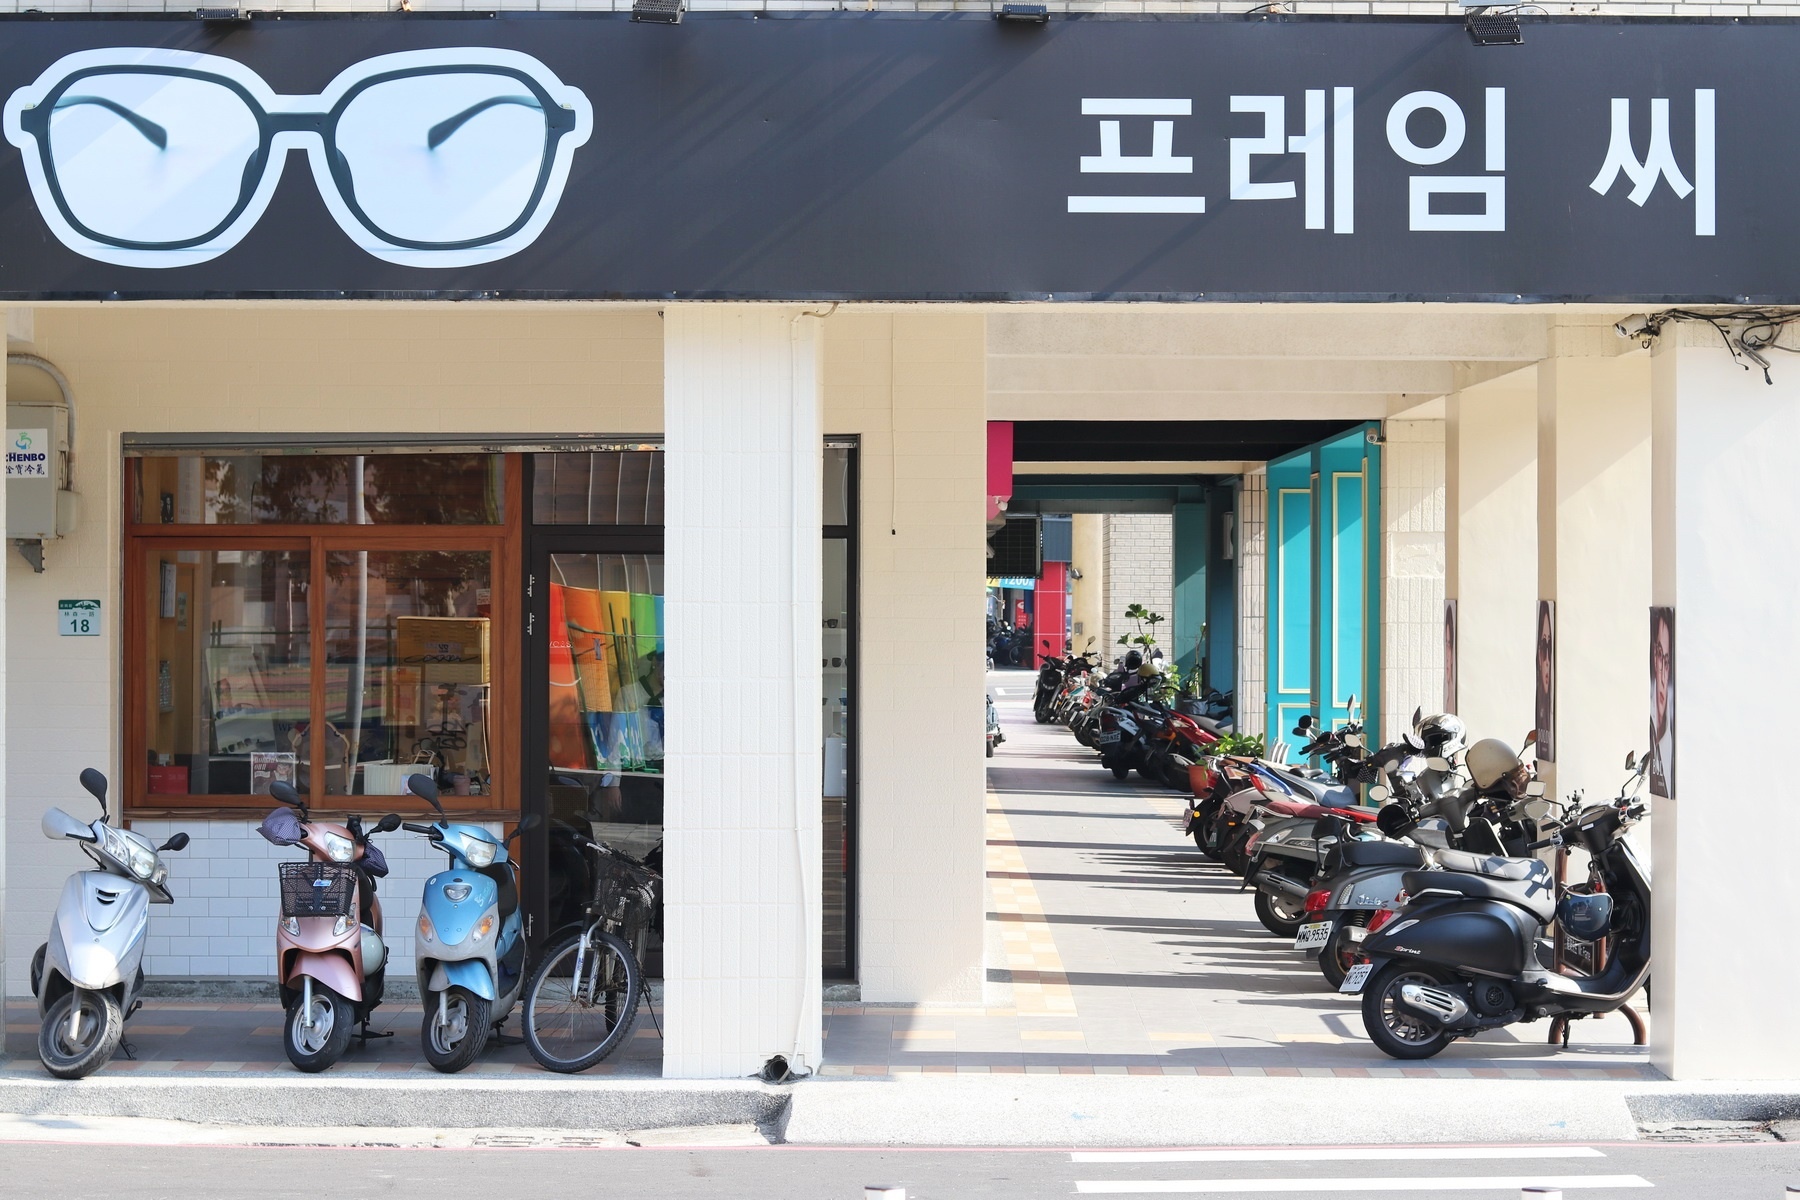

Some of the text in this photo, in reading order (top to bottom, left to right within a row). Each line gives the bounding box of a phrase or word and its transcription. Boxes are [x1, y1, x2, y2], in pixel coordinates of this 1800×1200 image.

[1067, 86, 1716, 236] 프레임 씨
[6, 452, 46, 462] HENBO
[70, 618, 90, 633] 18
